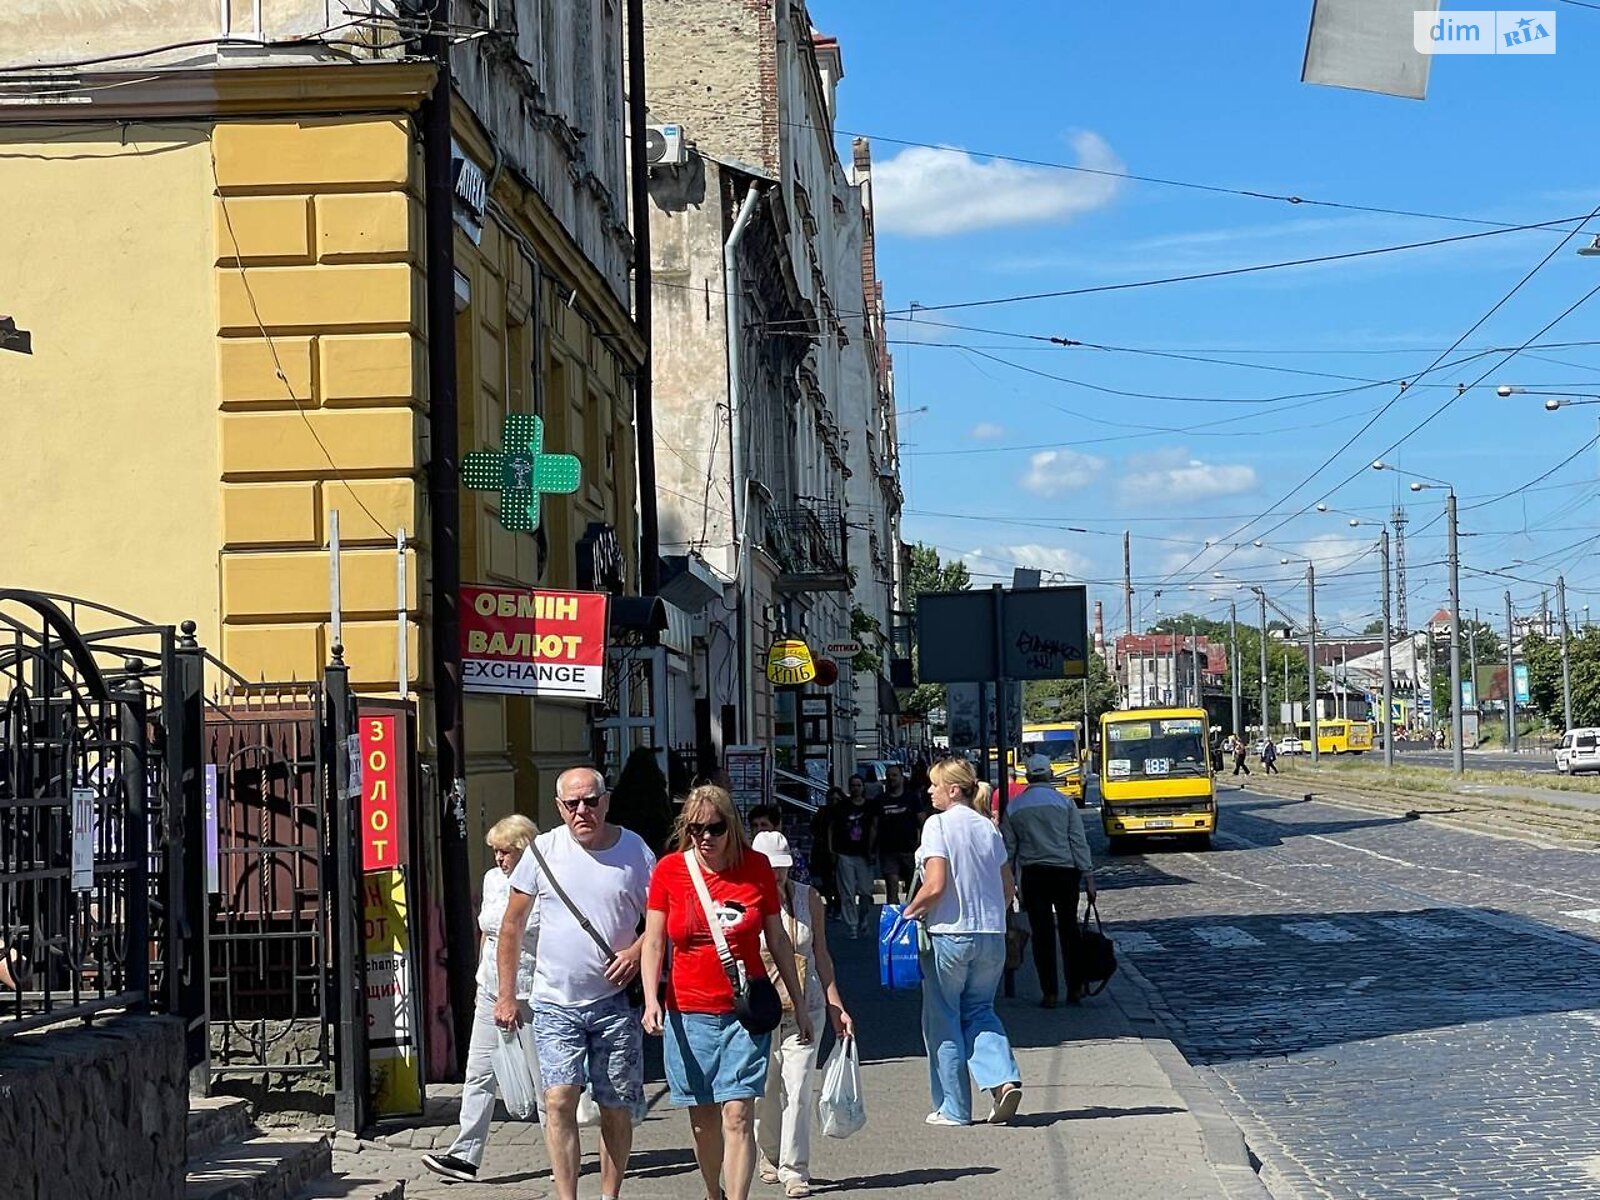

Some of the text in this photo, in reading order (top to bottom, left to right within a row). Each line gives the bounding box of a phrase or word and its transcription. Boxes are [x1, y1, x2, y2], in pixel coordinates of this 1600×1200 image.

[474, 592, 579, 621] ОБМІН
[468, 630, 583, 660] ВАЛЮТ
[827, 644, 859, 653] ОПТИКА
[462, 661, 586, 683] EXCHANGE
[1145, 759, 1169, 774] 183
